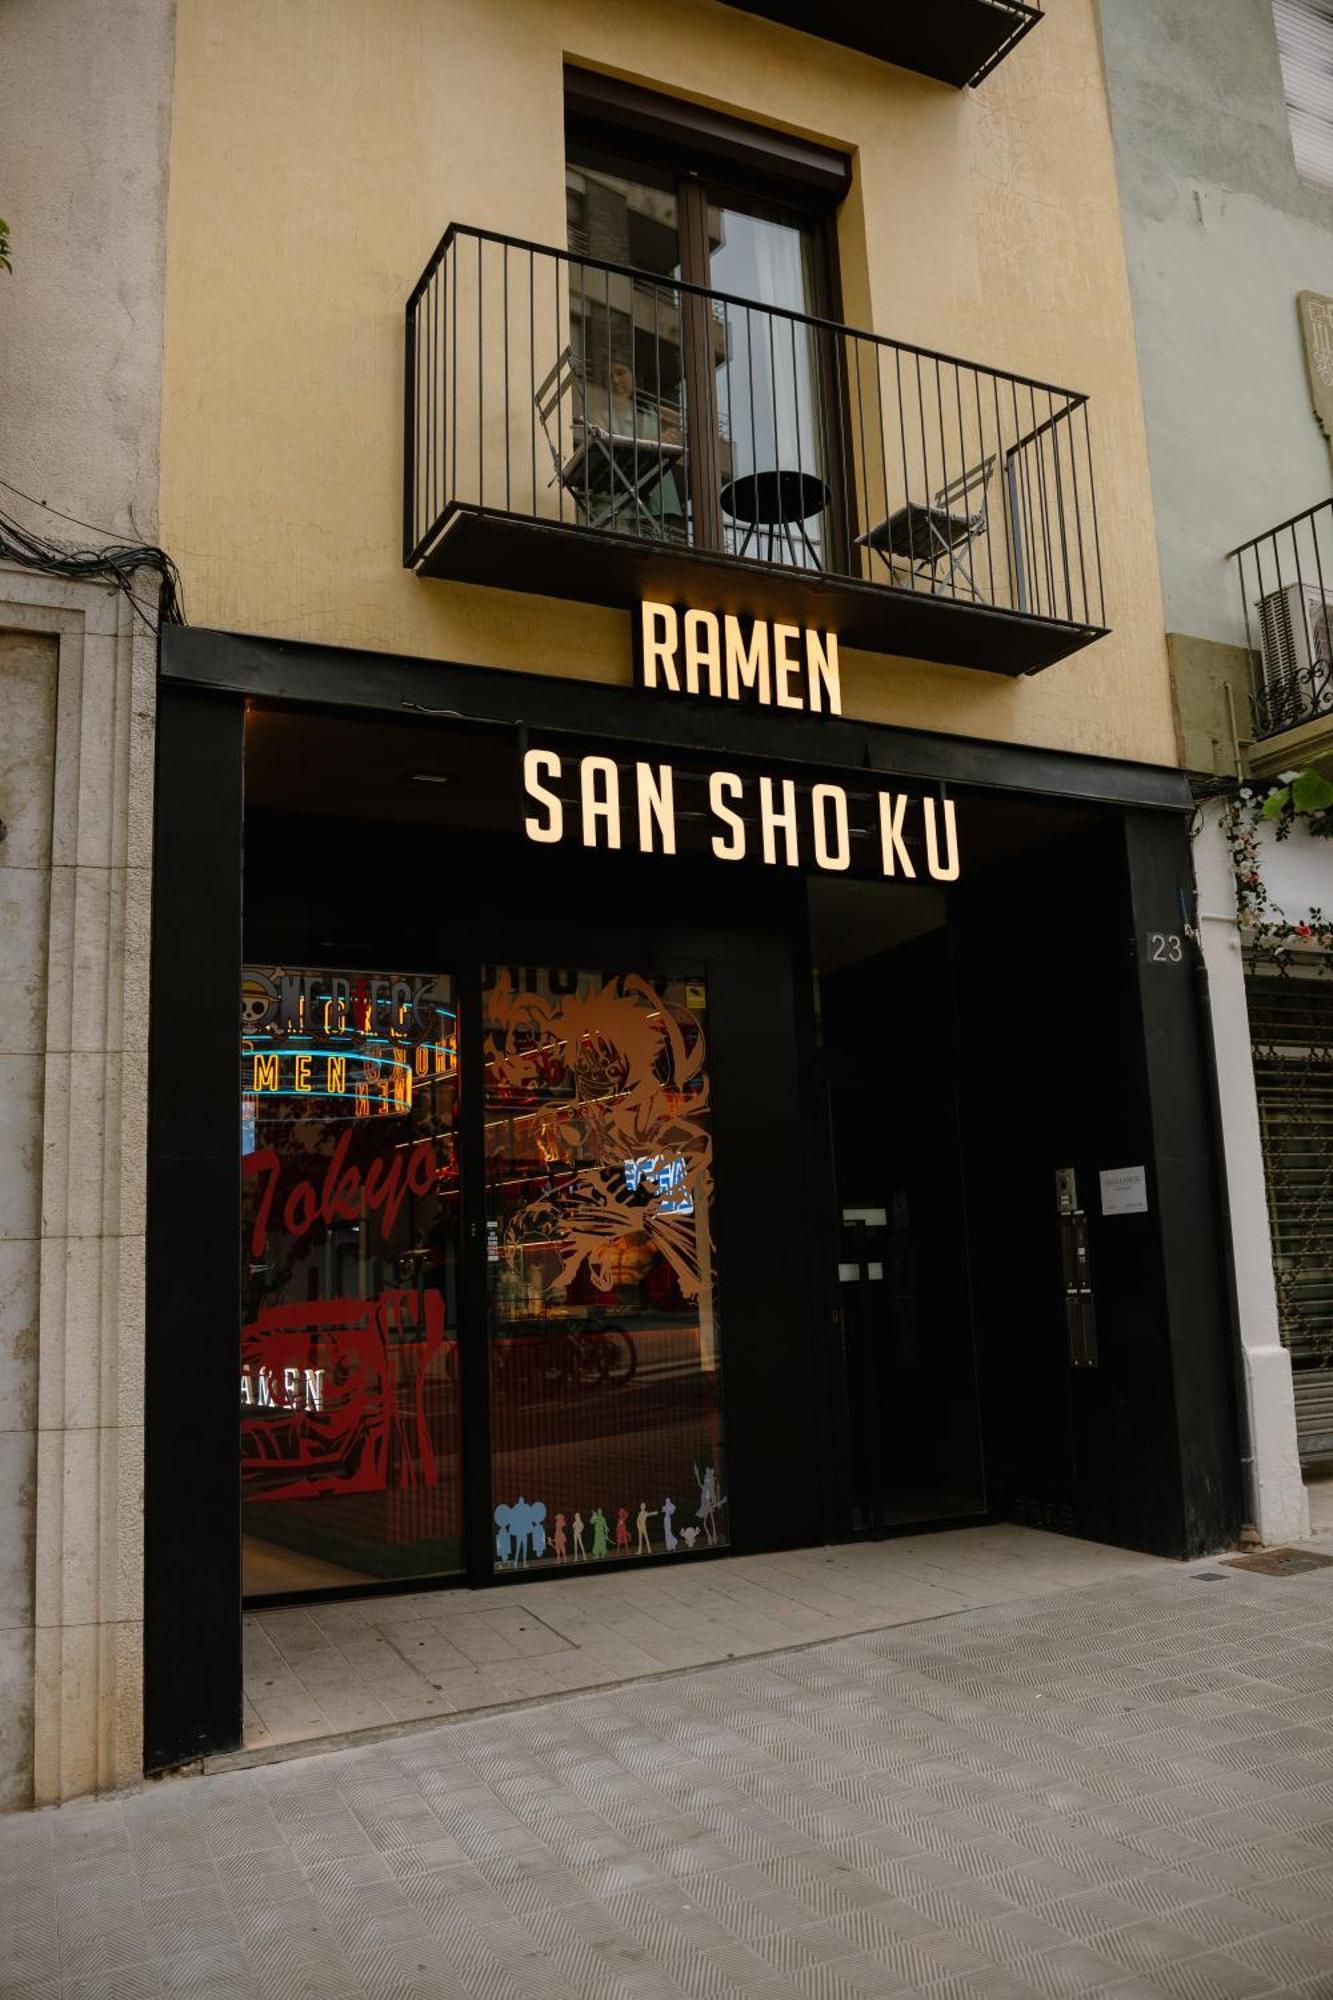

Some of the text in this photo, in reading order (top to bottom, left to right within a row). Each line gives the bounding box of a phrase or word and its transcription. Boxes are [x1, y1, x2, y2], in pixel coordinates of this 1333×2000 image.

[641, 600, 842, 716] RAMEN
[523, 748, 960, 882] SAN SHO KU
[1152, 934, 1182, 962] 23
[241, 1127, 437, 1259] Tokyo
